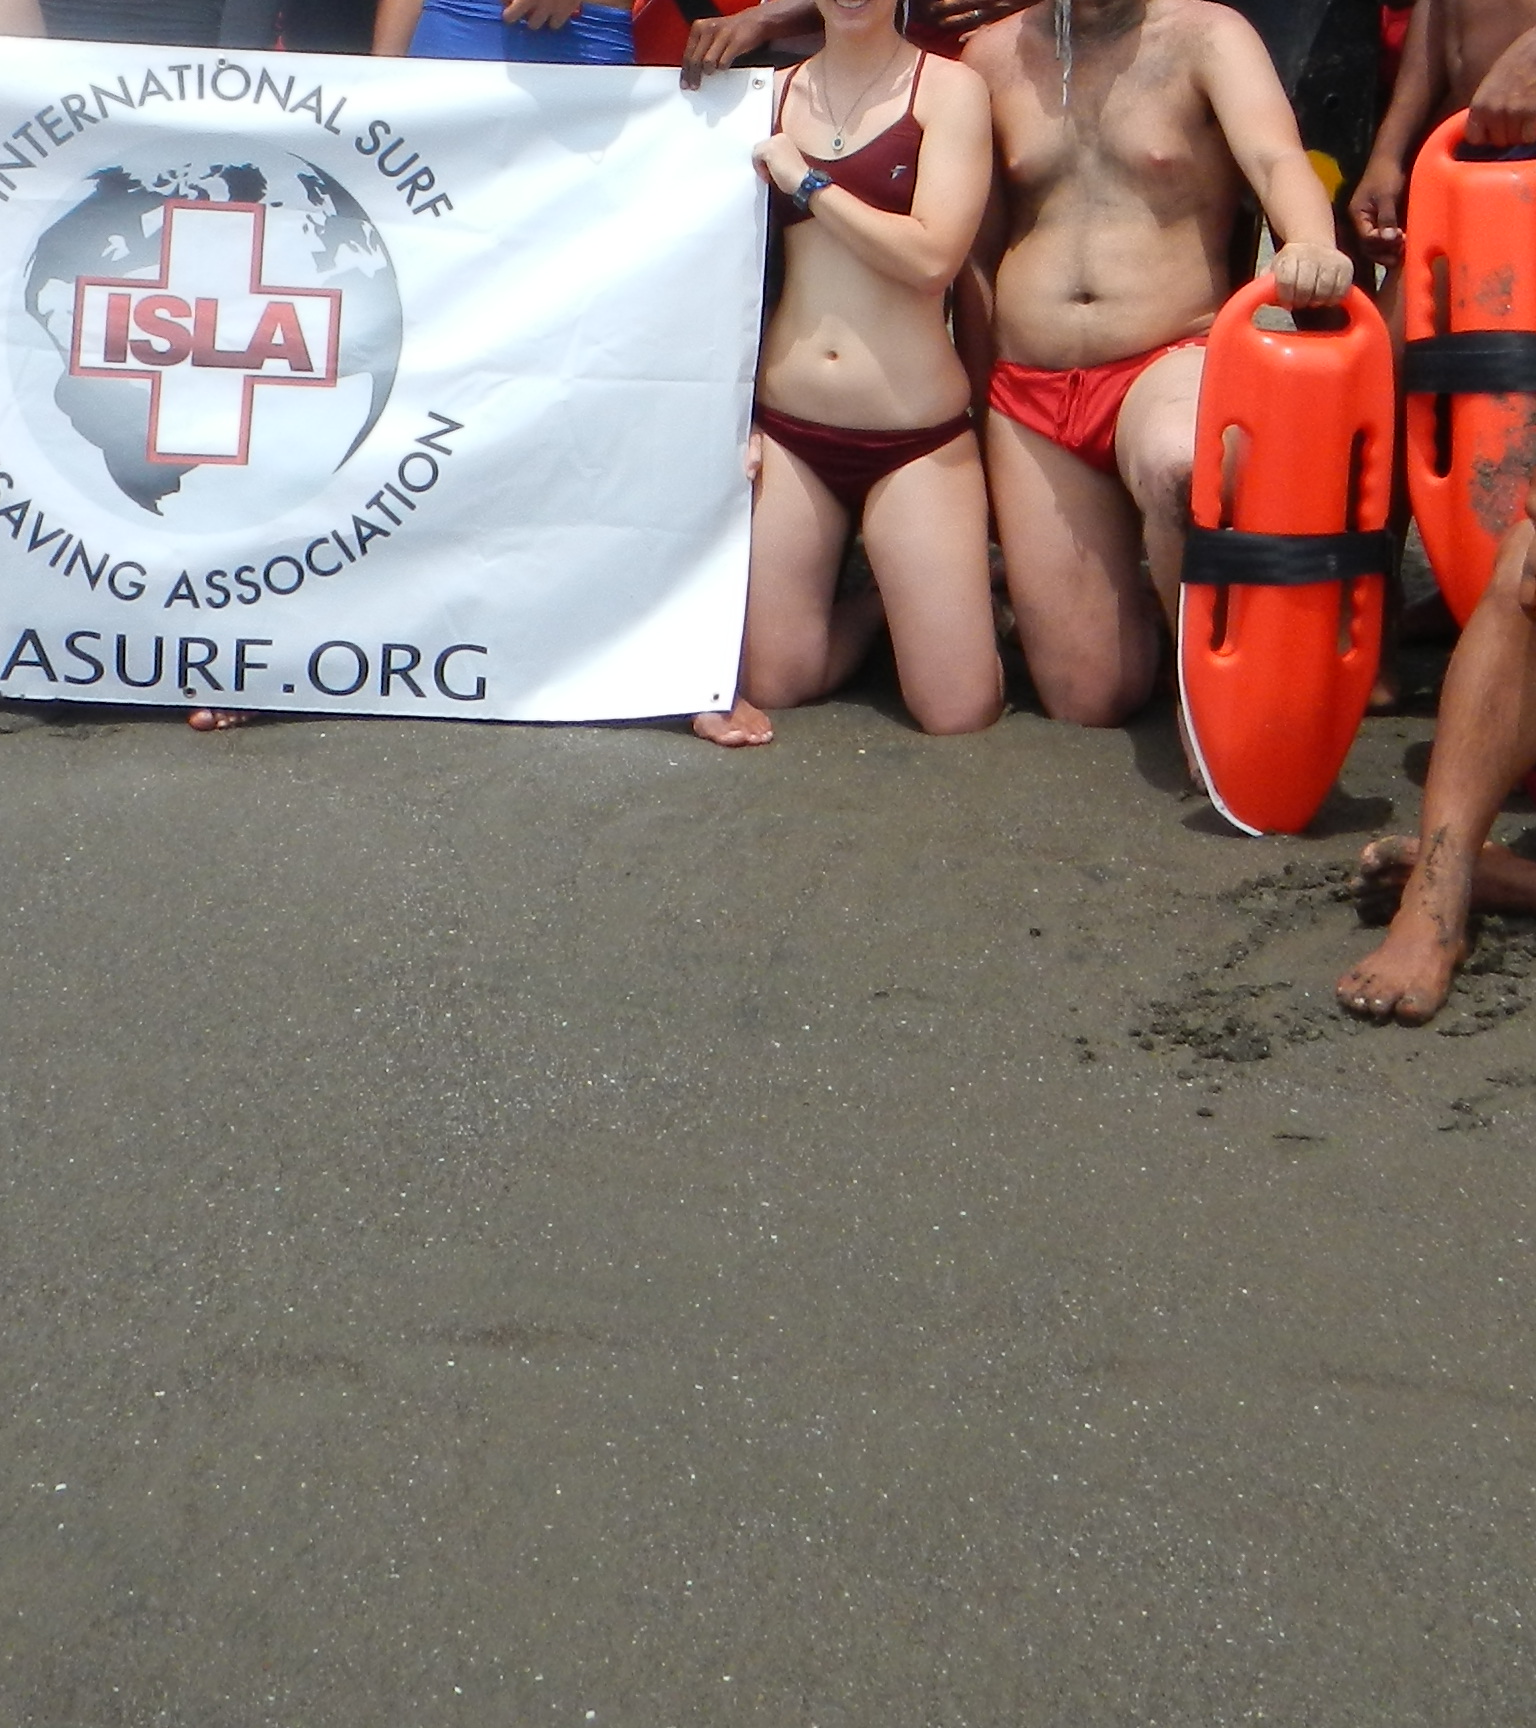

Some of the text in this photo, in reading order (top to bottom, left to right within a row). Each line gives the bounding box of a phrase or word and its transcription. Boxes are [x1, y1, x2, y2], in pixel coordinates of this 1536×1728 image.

[354, 119, 455, 220] SURF
[103, 292, 315, 373] ISLA
[164, 410, 465, 610] ASSOCIATION
